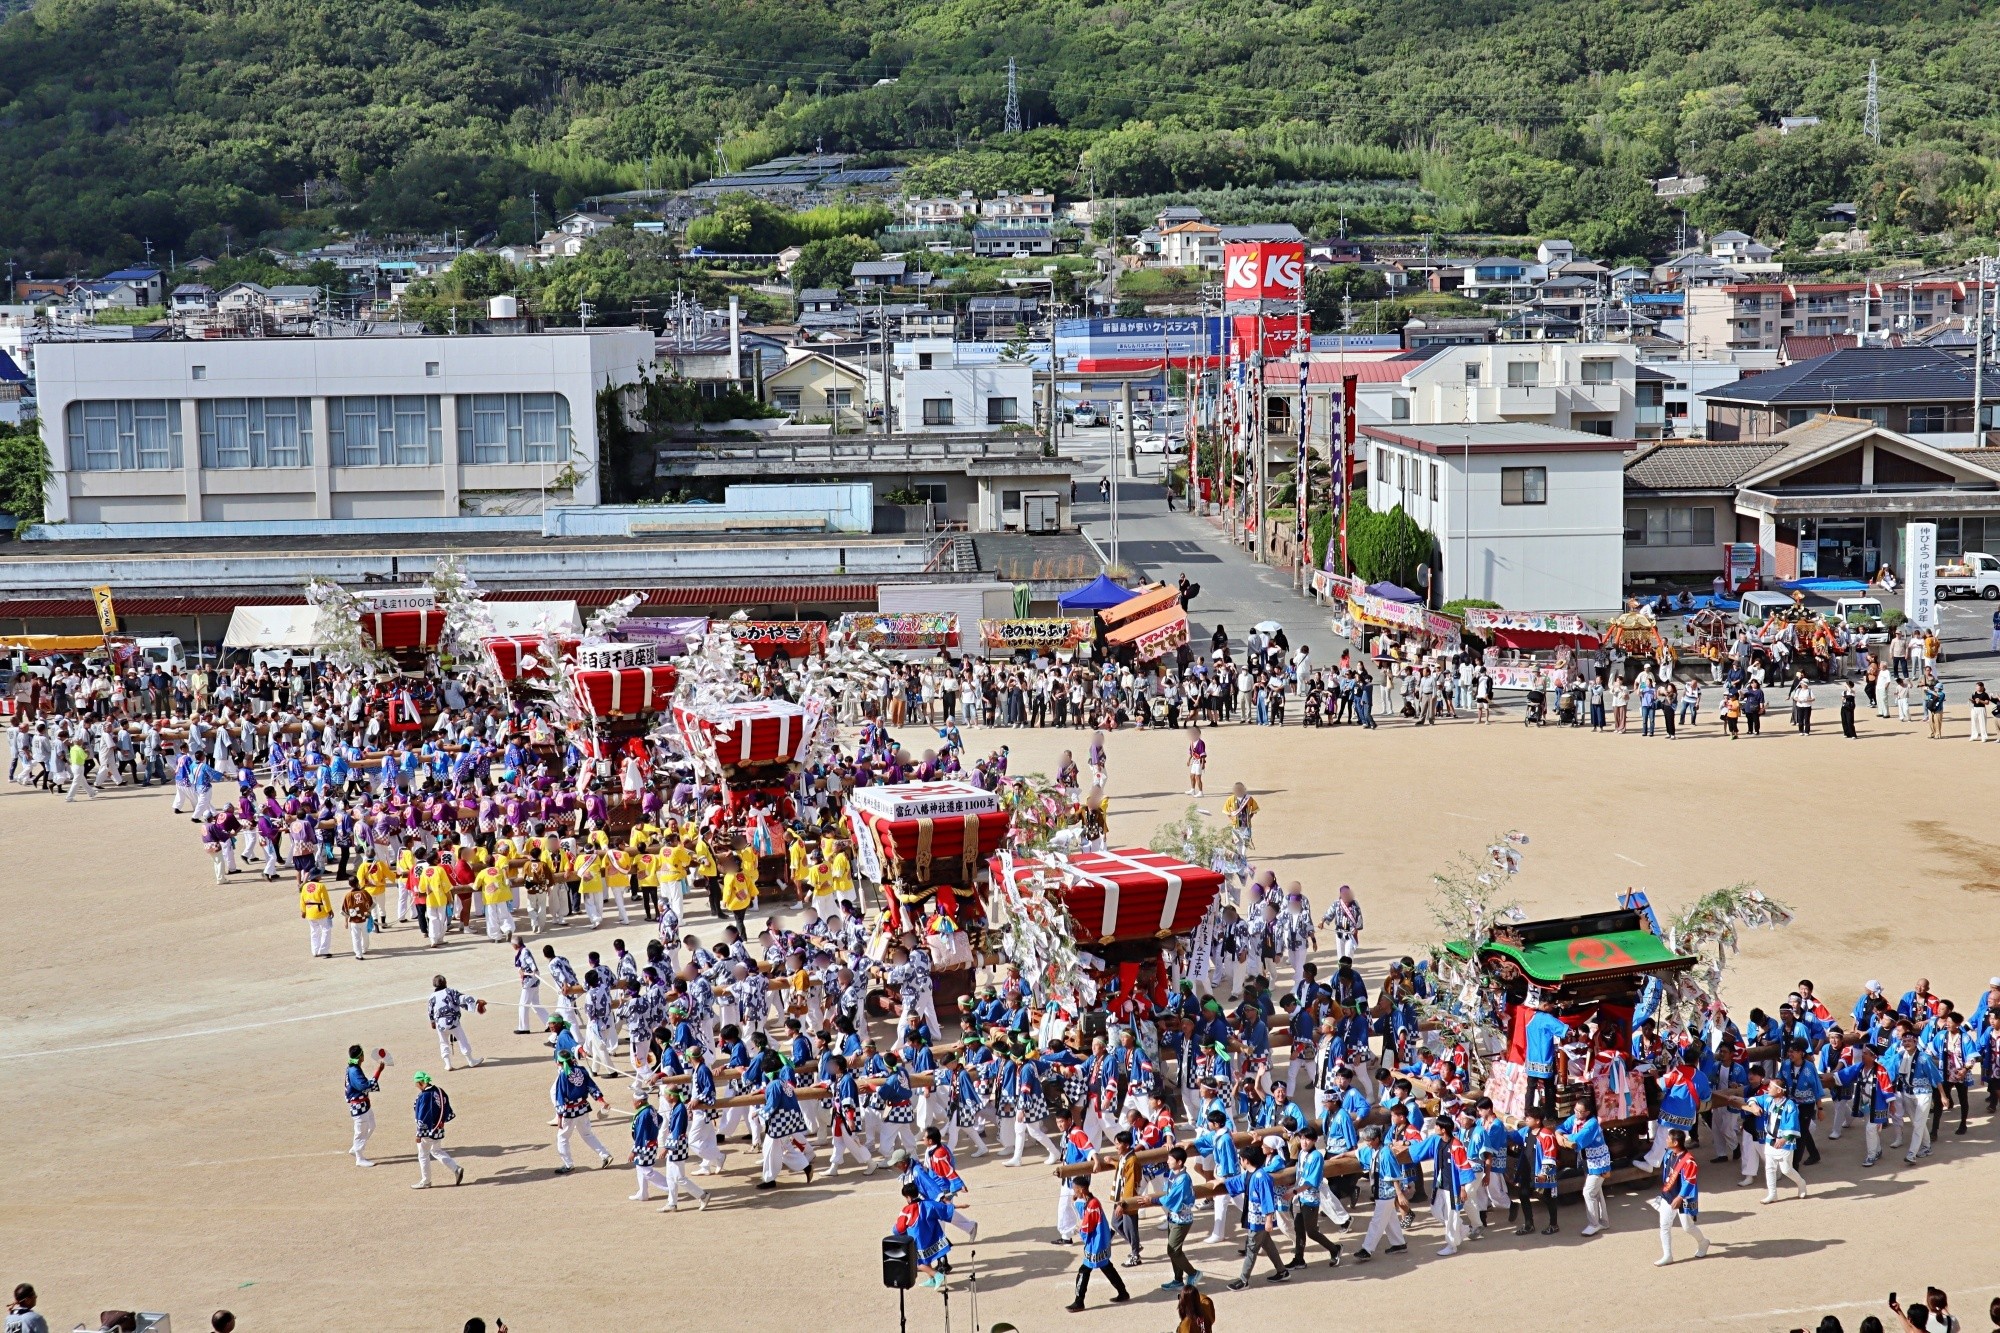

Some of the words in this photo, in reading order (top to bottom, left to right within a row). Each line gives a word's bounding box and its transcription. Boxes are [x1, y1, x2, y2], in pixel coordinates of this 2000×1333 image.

[1487, 614, 1558, 630] フルーツ飴
[1000, 623, 1071, 638] 俺のからあげ
